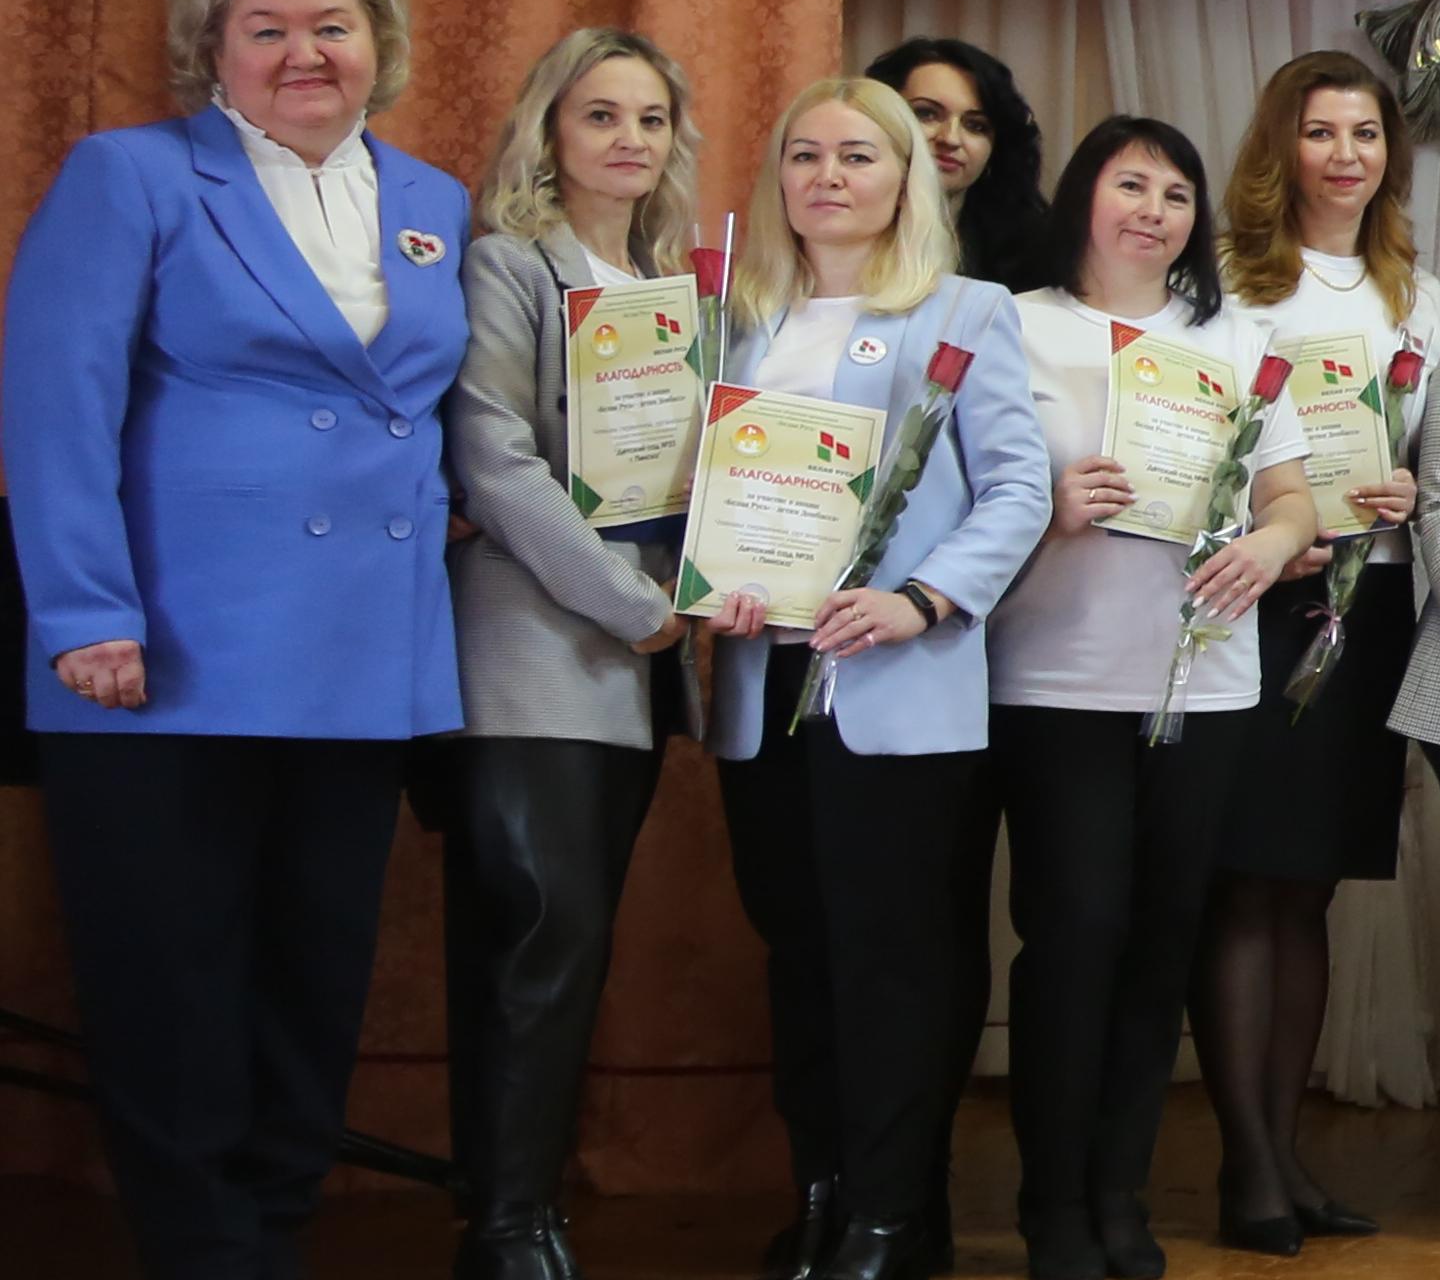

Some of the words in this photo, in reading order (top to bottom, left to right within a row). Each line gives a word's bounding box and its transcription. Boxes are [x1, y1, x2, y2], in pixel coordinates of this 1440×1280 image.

[595, 362, 684, 384] БЛАГОДАРНОСТЬ
[1135, 392, 1225, 424] БЛАГОДАРНОСТЬ
[1297, 400, 1357, 417] ДАРНОСТЬ
[729, 466, 843, 495] БЛАГОДАРНОСТЬ
